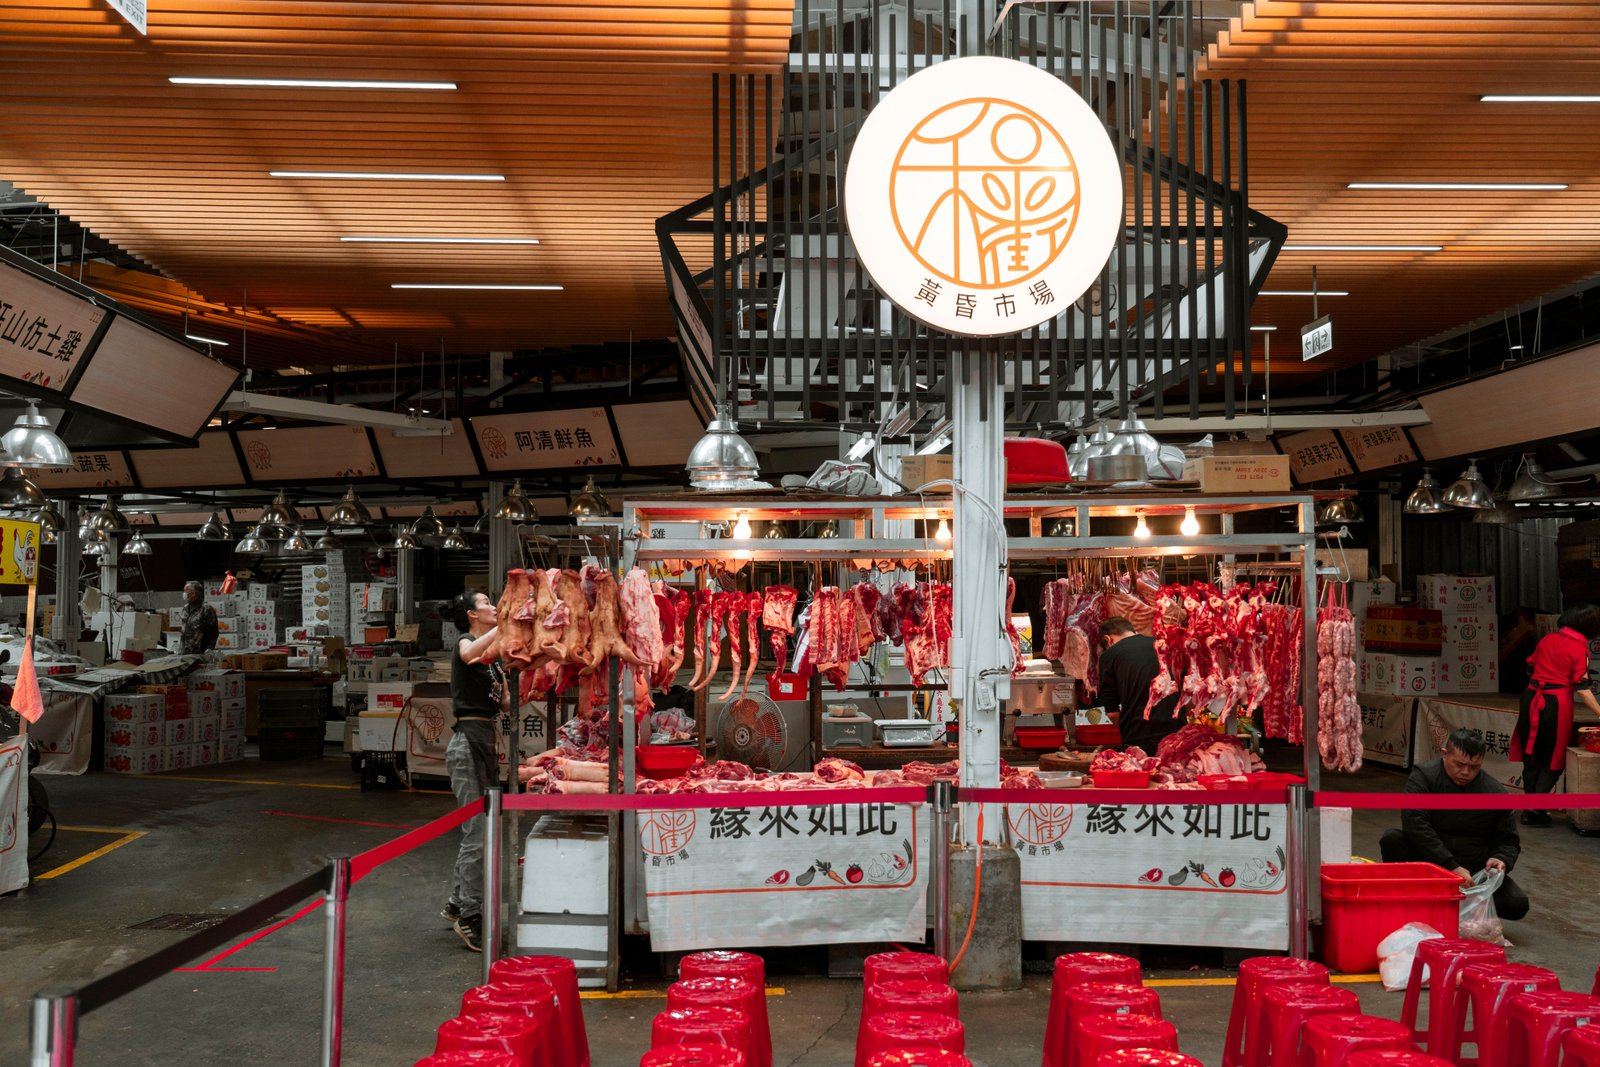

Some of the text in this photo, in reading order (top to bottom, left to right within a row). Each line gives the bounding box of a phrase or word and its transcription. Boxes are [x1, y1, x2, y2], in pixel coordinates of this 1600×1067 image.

[914, 278, 1055, 320] 黃昏市場
[514, 427, 596, 452] 阿清鮮魚
[709, 802, 898, 840] 緣來如此
[1085, 803, 1272, 842] 緣來如此
[1013, 838, 1065, 857] 黃昏市場
